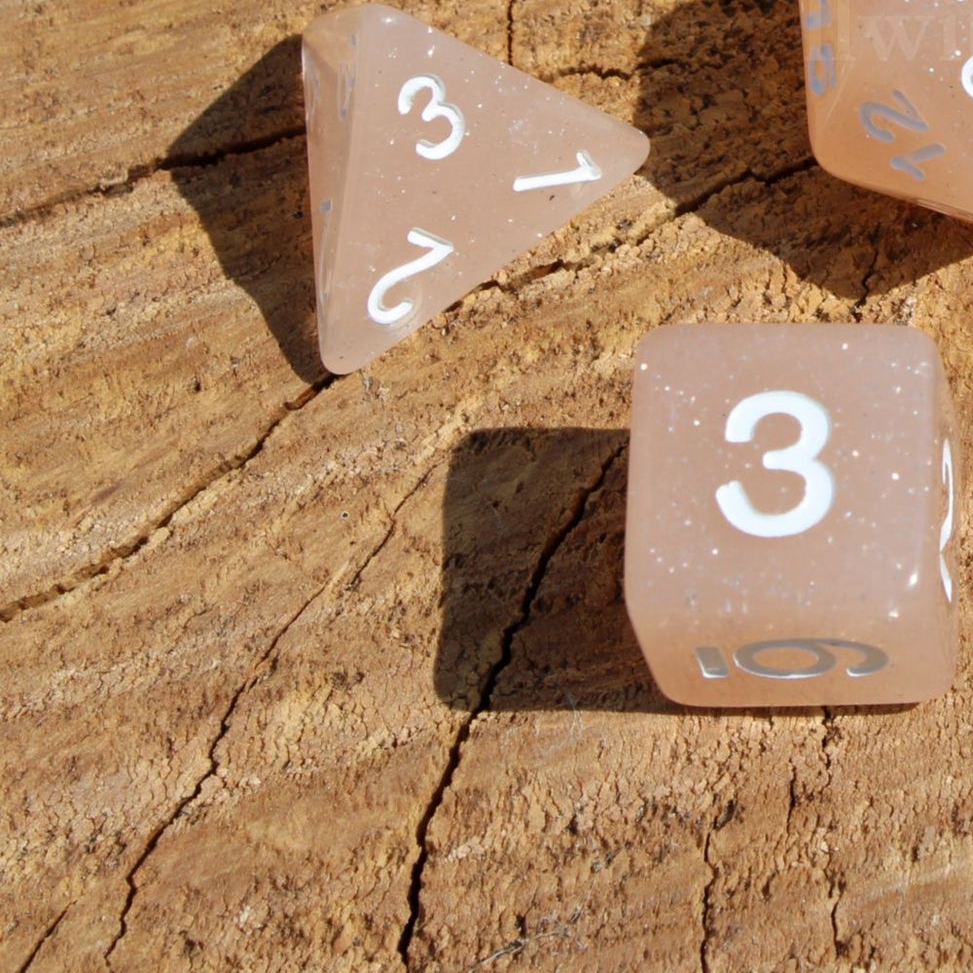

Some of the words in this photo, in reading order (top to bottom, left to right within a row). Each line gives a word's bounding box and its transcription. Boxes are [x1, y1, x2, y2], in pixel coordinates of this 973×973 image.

[398, 74, 466, 160] 3
[512, 149, 602, 192] 1
[367, 227, 454, 324] 2
[715, 390, 835, 538] 3
